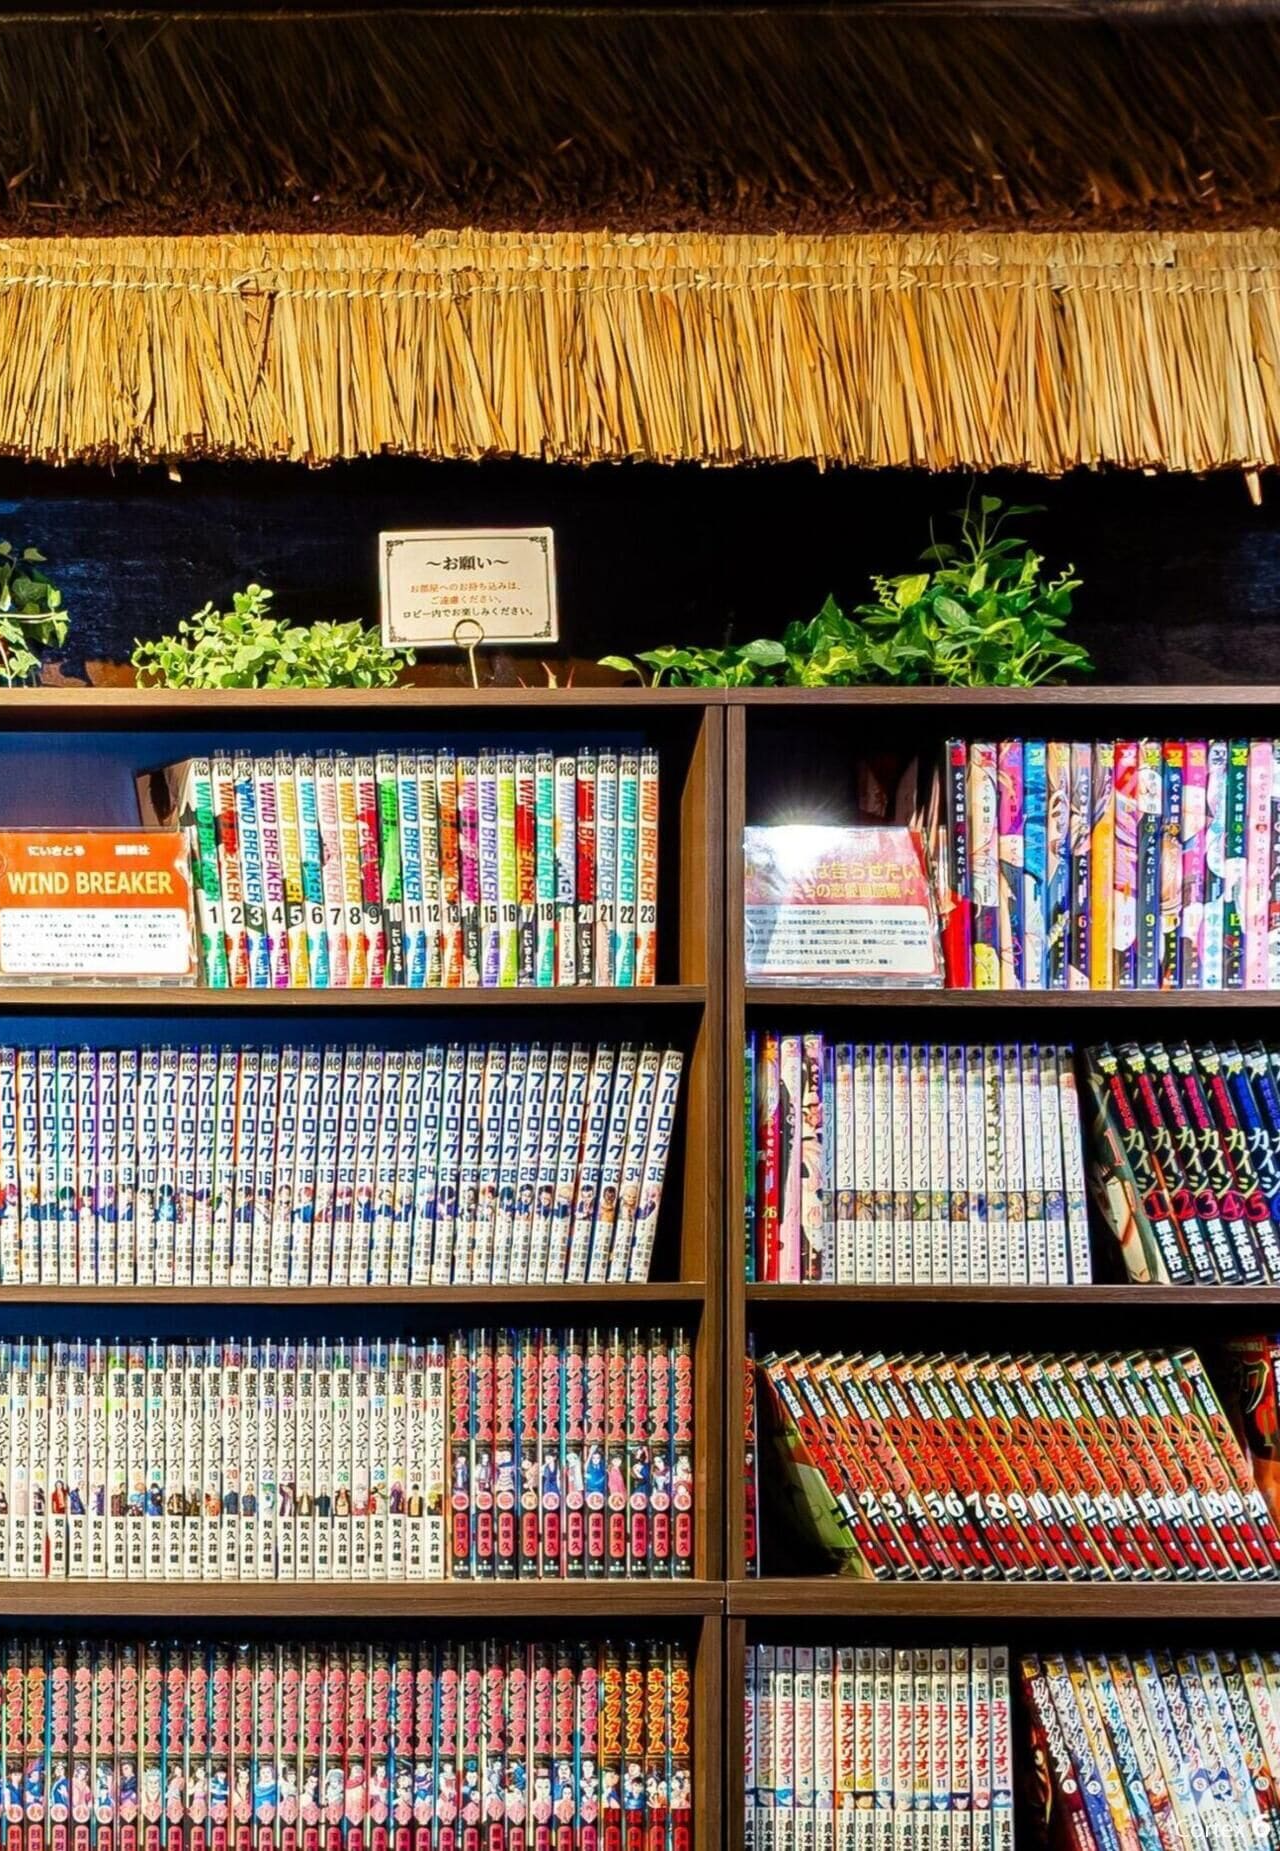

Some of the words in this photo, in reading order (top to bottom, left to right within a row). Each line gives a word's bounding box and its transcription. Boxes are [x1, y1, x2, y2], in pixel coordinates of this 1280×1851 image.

[195, 782, 216, 828] WIND
[260, 782, 277, 828] WIND
[341, 782, 356, 823] WIND
[401, 780, 417, 822] WIND
[420, 779, 436, 823] WIND
[480, 780, 496, 822] WIND
[499, 779, 514, 821] WIND
[538, 778, 553, 820] WIND
[263, 829, 284, 902] BREAKER
[301, 782, 318, 828] WIND
[312, 907, 323, 924] 6
[342, 829, 362, 902] BREAKER
[404, 828, 422, 902] BREAKER
[422, 826, 440, 901] BREAKER
[481, 827, 498, 902] BREAKER
[500, 825, 516, 901] BREAKER
[538, 825, 554, 901] BREAKER
[599, 826, 616, 901] BREAKER
[198, 833, 220, 902] BREAKER
[7, 871, 70, 895] WIND
[76, 871, 174, 895] BREAKER
[209, 907, 218, 924] 1
[231, 907, 242, 924] 2
[251, 907, 263, 924] 3
[272, 907, 284, 924] 4
[291, 907, 304, 924] 5
[330, 908, 341, 925] 7
[349, 907, 361, 924] 8
[409, 906, 421, 923] 11
[427, 905, 440, 923] 12
[447, 906, 459, 923] 13
[484, 906, 496, 923] 15
[502, 905, 516, 922] 16
[540, 904, 553, 922] 18
[600, 905, 614, 923] 21
[620, 907, 634, 924] 22
[641, 906, 655, 923] 23
[1078, 914, 1087, 927] 6
[1145, 914, 1156, 927] 9
[1, 1071, 15, 1156] ブルーロック
[42, 1072, 57, 1157] ブルーロック
[342, 1074, 360, 1159] ブルーロック
[422, 1071, 440, 1156] ブルーロック
[505, 1074, 524, 1160] ブルーロック
[1124, 1129, 1158, 1199] カイジ
[1152, 1128, 1185, 1198] カイジ
[1175, 1127, 1209, 1198] カイジ
[1198, 1128, 1233, 1199] カイジ
[226, 1470, 238, 1479] 20
[245, 1472, 255, 1481] 21
[263, 1470, 274, 1480] 22
[282, 1472, 293, 1481] 23
[410, 1472, 421, 1482] 30
[838, 1493, 856, 1517] 1
[860, 1491, 880, 1517] 2
[882, 1491, 903, 1517] 3
[925, 1491, 945, 1517] 5
[966, 1492, 985, 1518] 7
[986, 1493, 1007, 1518] 8
